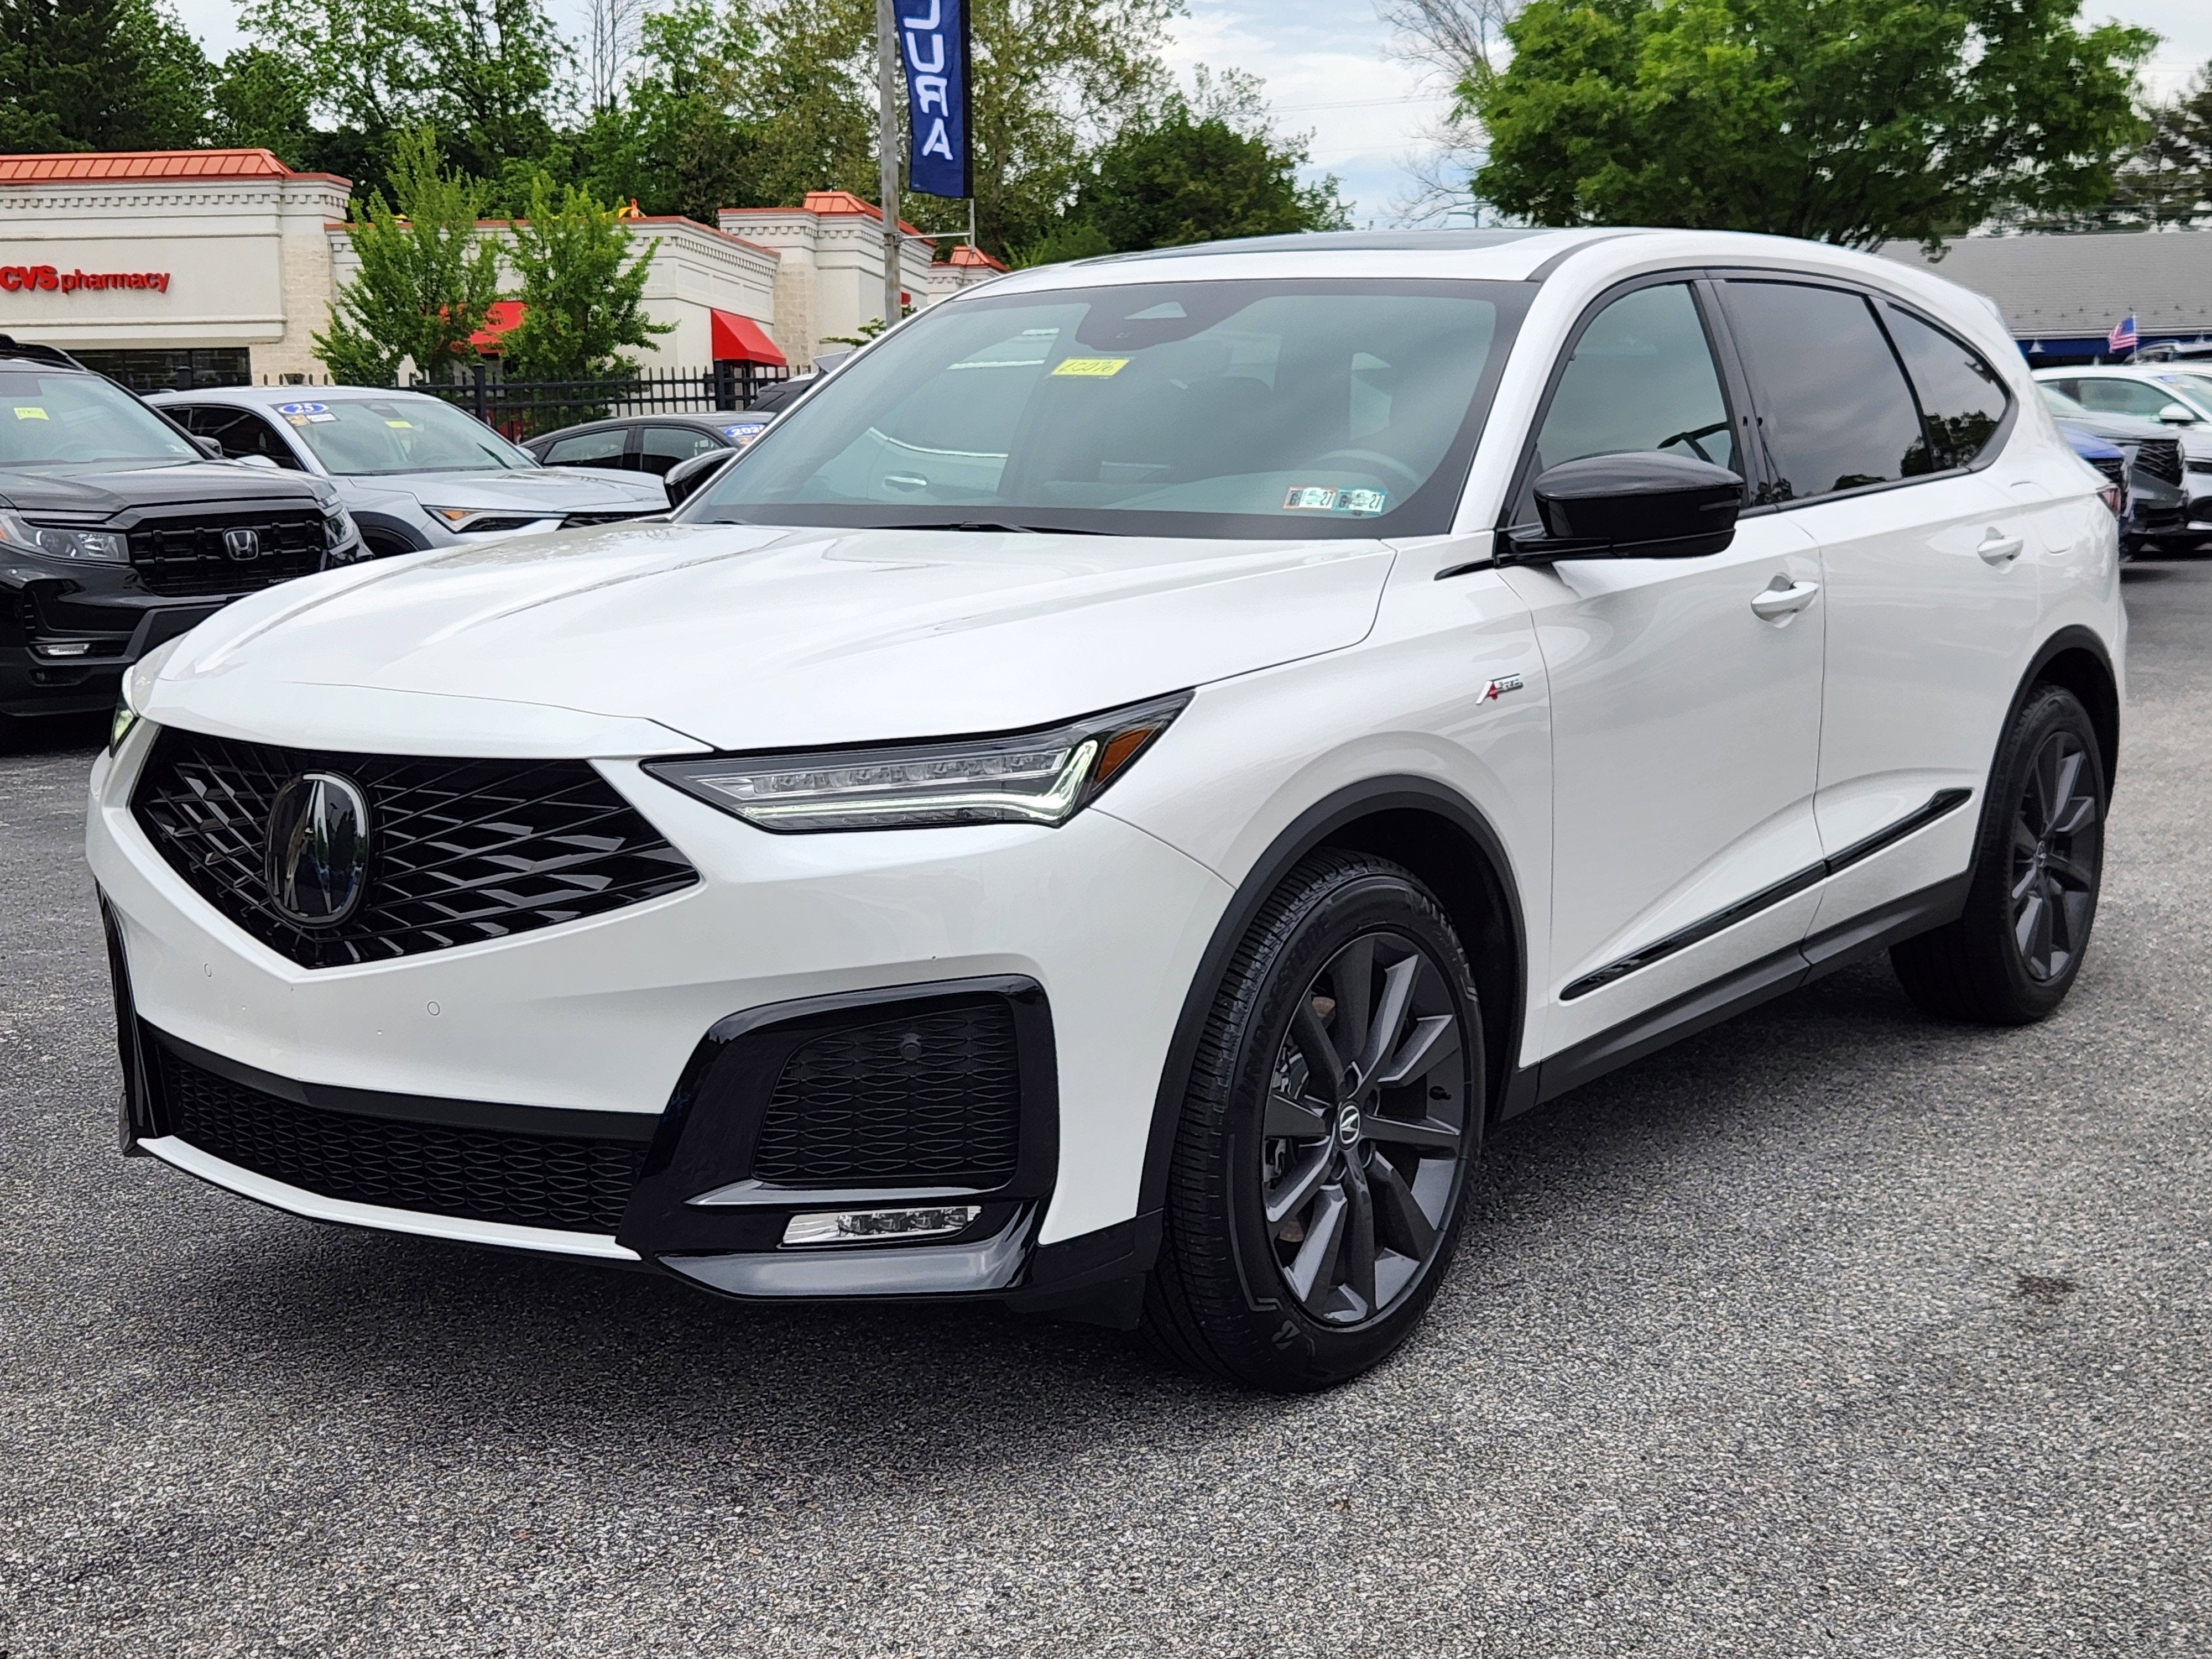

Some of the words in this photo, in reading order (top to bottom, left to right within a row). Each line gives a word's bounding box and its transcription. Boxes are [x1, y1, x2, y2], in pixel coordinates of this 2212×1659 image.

[0, 265, 59, 291] CVS
[61, 269, 170, 294] pharmacy
[293, 403, 315, 413] 25
[1319, 491, 1334, 507] 27
[1369, 494, 1383, 509] 27
